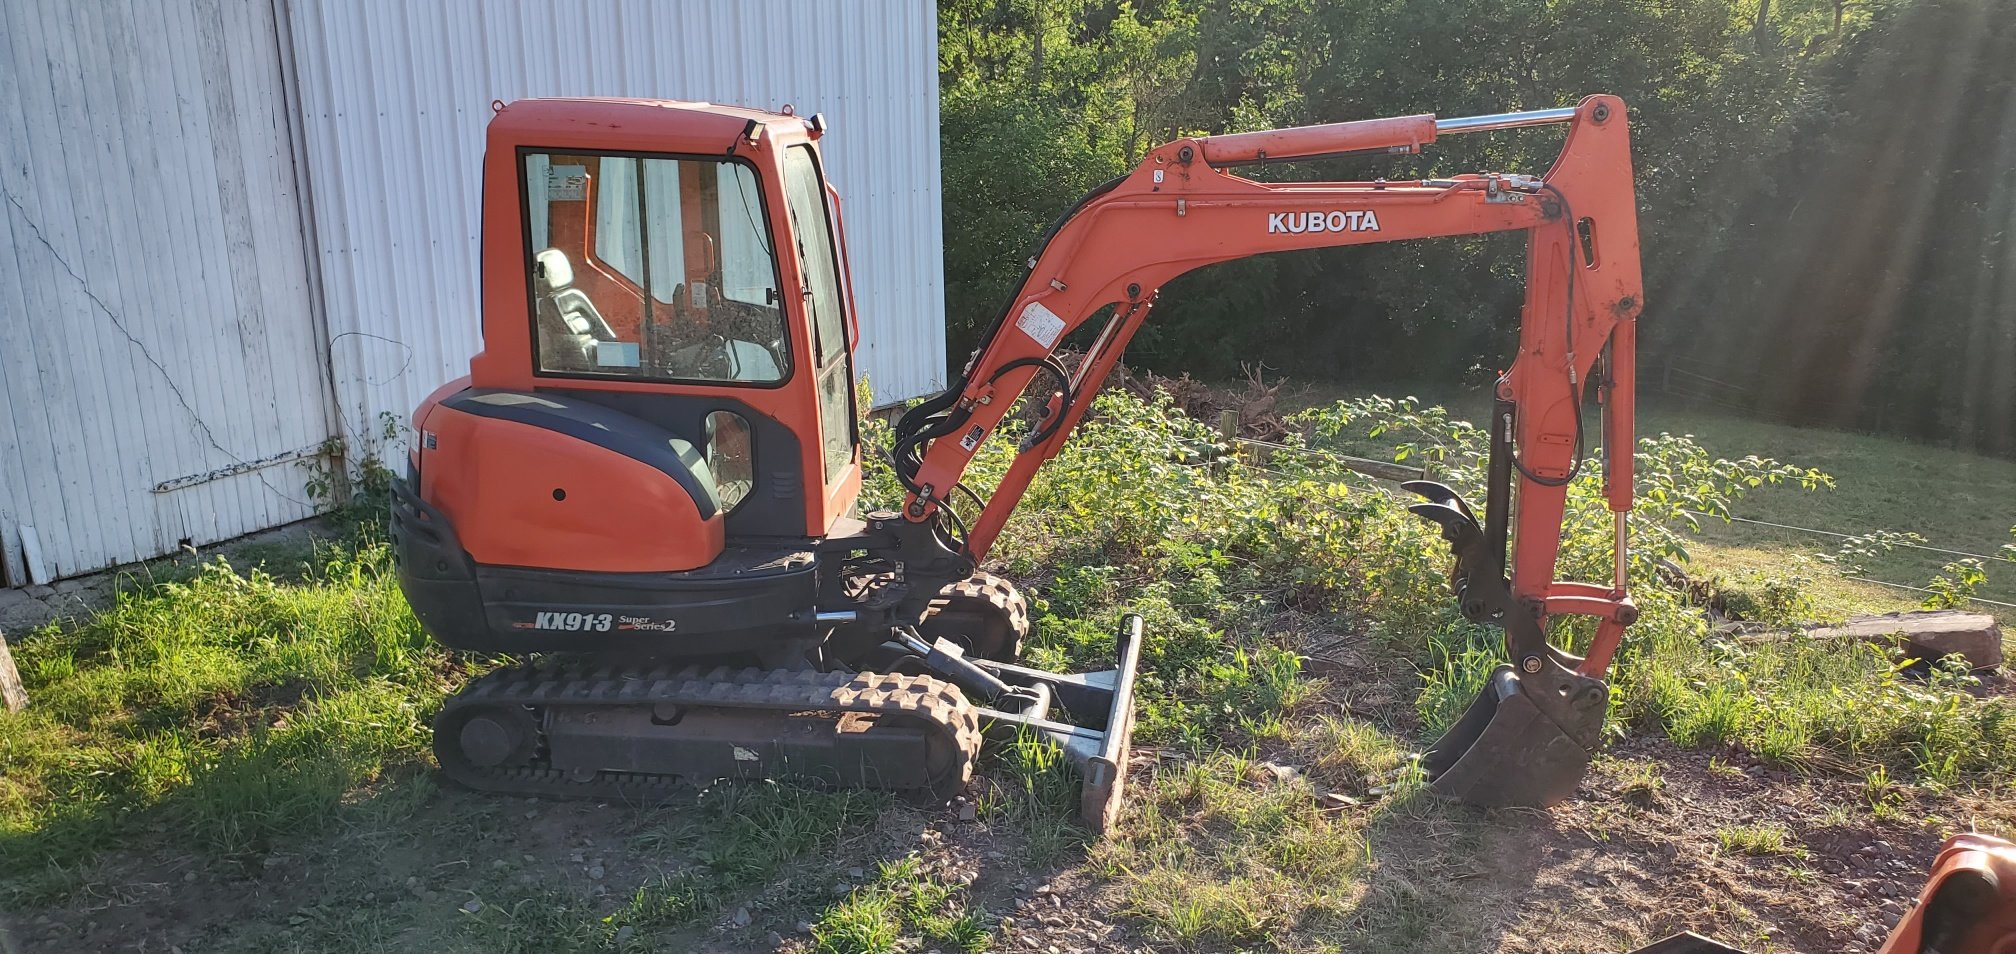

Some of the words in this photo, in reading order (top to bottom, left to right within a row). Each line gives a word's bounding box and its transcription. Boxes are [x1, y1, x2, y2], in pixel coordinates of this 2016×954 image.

[1268, 210, 1380, 233] KUBOTA
[535, 611, 613, 631] KX91-3
[618, 615, 650, 624] Super
